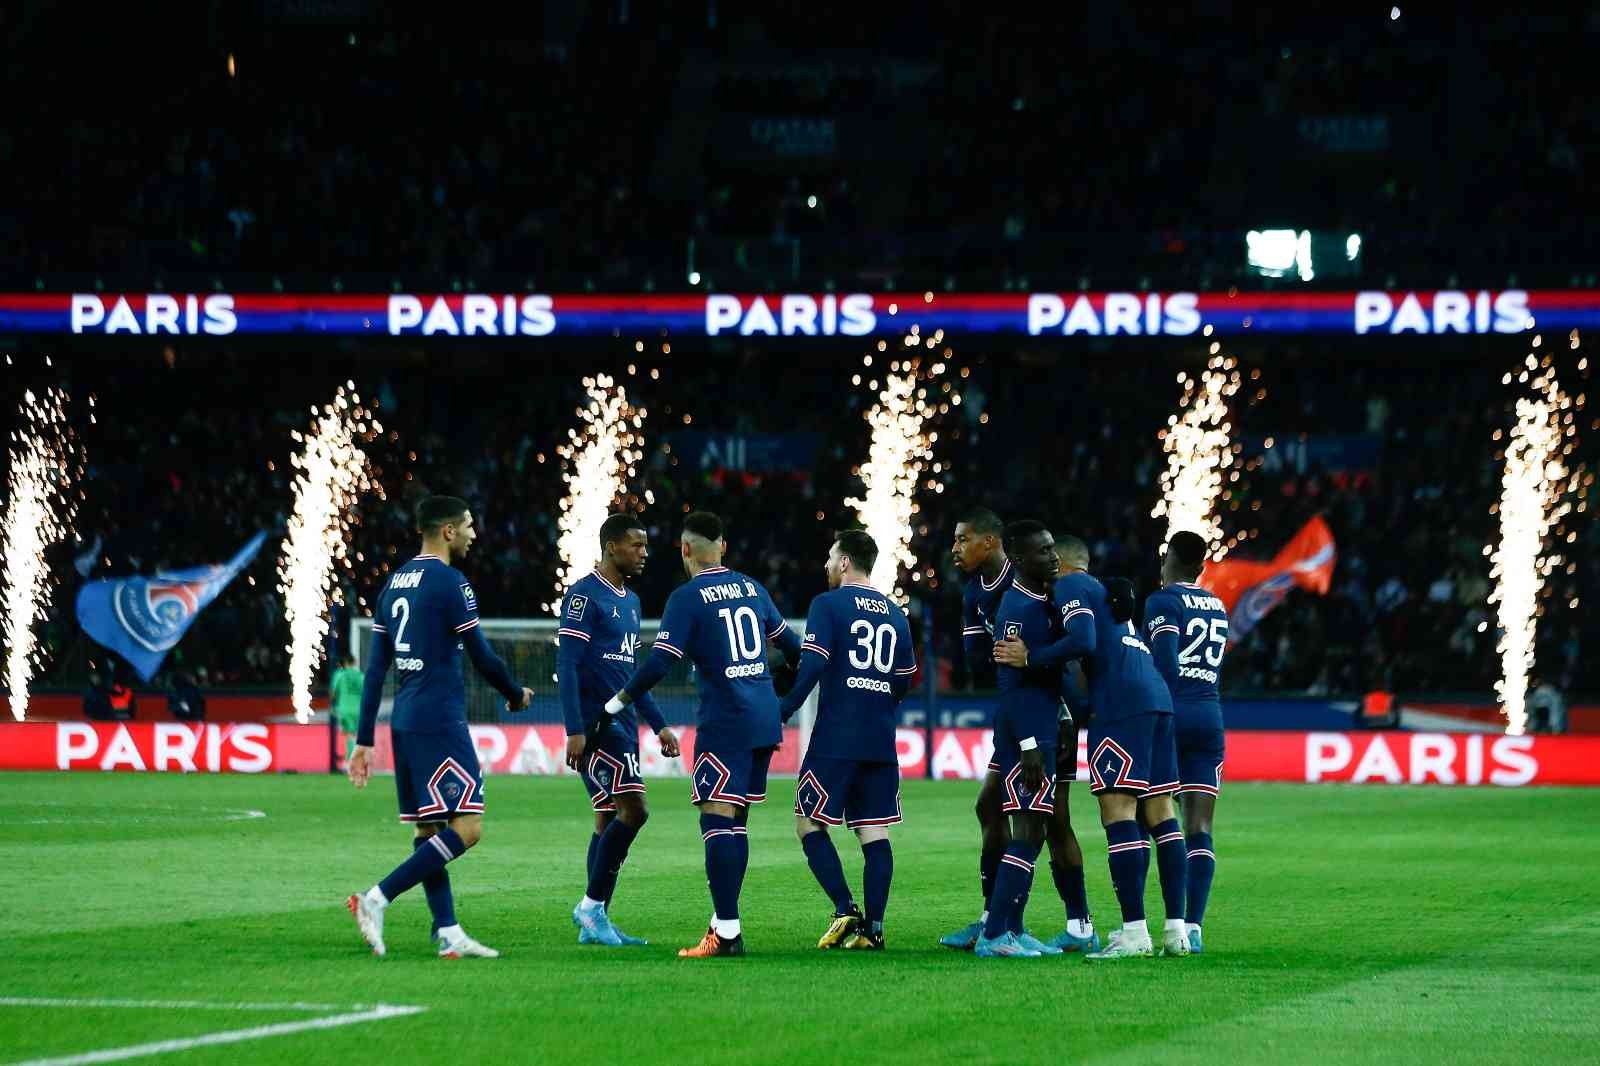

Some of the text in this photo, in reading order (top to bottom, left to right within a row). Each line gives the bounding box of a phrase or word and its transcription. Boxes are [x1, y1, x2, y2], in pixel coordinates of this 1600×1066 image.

[71, 293, 237, 335] PARIS
[388, 294, 557, 336] PARIS
[706, 294, 877, 336] PARIS
[1028, 293, 1201, 336] PARIS
[1355, 291, 1531, 334] PARIS
[700, 583, 743, 604] NEYMAR
[855, 597, 890, 615] MESSI
[391, 597, 411, 652] 2
[656, 631, 670, 640] NB
[718, 606, 762, 662] 10
[1178, 618, 1229, 667] 25
[848, 620, 897, 674] 30
[57, 722, 273, 772] PARIS
[1305, 732, 1540, 786] PARIS
